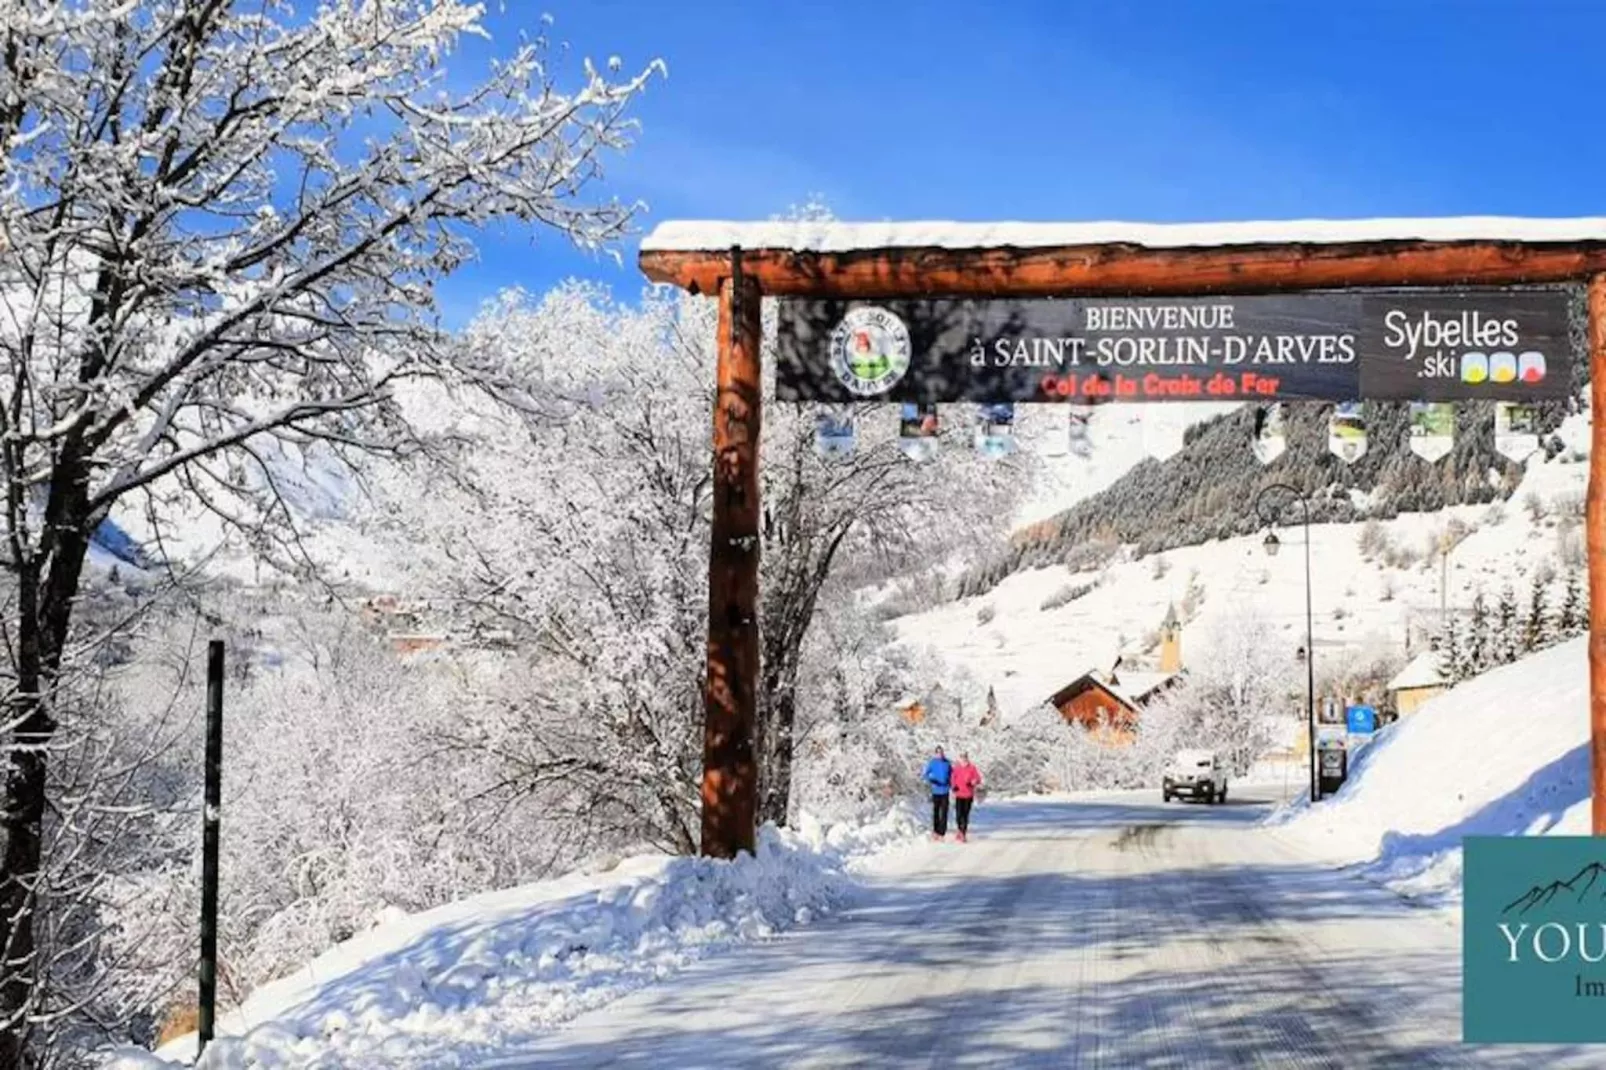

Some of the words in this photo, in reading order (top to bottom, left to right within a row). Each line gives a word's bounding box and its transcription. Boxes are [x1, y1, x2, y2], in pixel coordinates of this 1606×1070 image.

[1085, 305, 1234, 330] BIENVENUE
[1384, 310, 1519, 360] Sybelles
[970, 337, 986, 366] à
[994, 335, 1356, 367] SAINT-SORLIN-D'ARVES
[1417, 350, 1456, 378] .ski
[1042, 375, 1076, 396] Col
[1081, 374, 1110, 396] de
[1115, 374, 1136, 395] la
[1143, 372, 1200, 395] Croix
[1206, 372, 1235, 395] de
[1241, 373, 1279, 394] Fer
